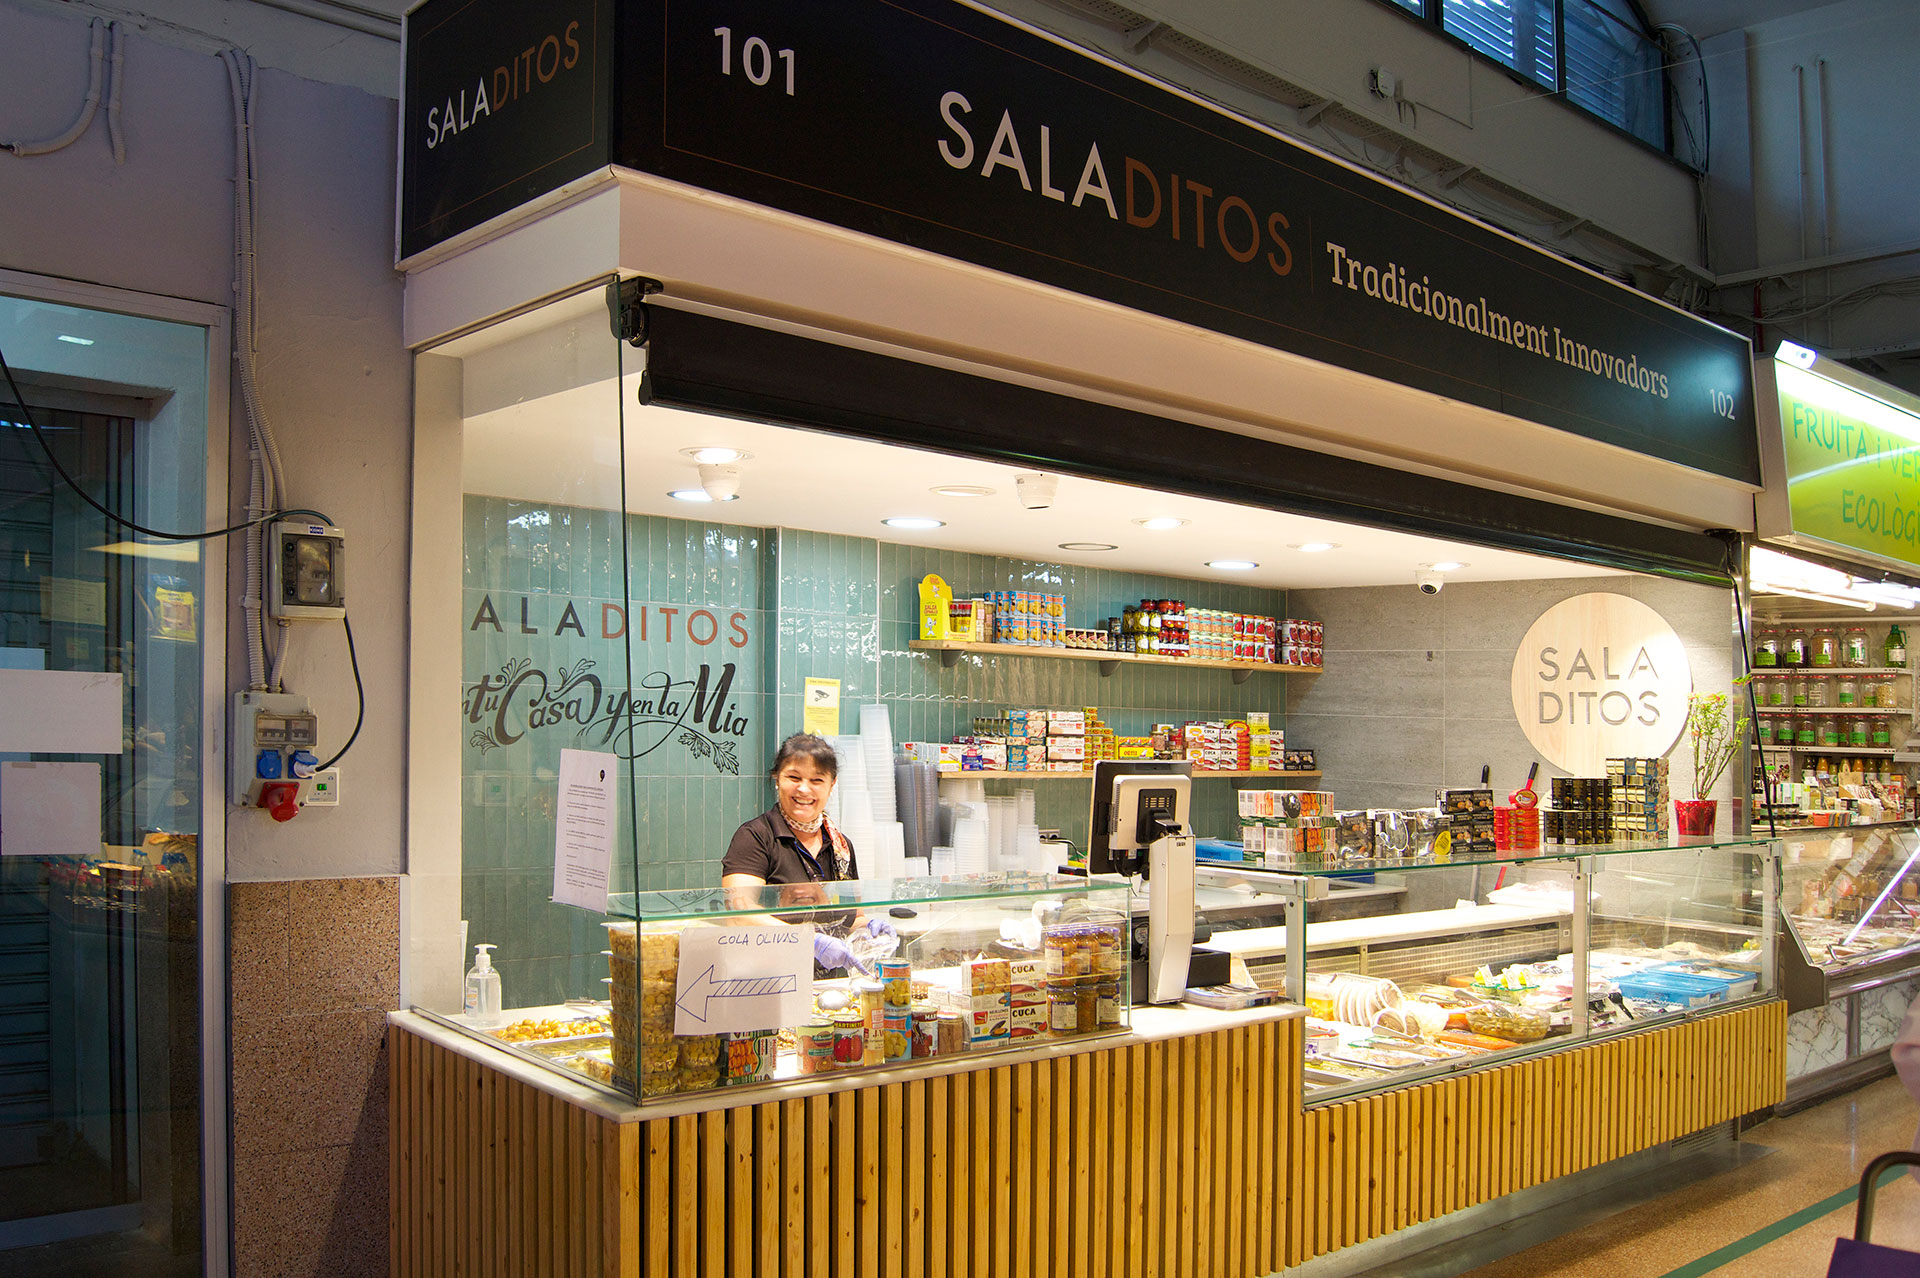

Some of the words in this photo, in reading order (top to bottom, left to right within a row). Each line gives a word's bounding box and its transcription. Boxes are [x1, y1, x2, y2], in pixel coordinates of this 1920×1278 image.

[427, 20, 580, 149] SALADITOS
[714, 26, 795, 97] 101
[937, 91, 1293, 276] SALADITOS
[1326, 241, 1549, 358] Tradicionalment
[1553, 326, 1669, 399] Innovadors
[1708, 388, 1736, 420] 102
[469, 593, 749, 648] ALADITOS
[1538, 646, 1660, 682] SALA
[494, 669, 603, 746] Casa
[1538, 690, 1661, 727] DITOS
[717, 933, 750, 946] COLA
[755, 932, 800, 945] OLIVAS
[1011, 964, 1036, 974] CUCA
[1011, 1007, 1037, 1018] CUCA
